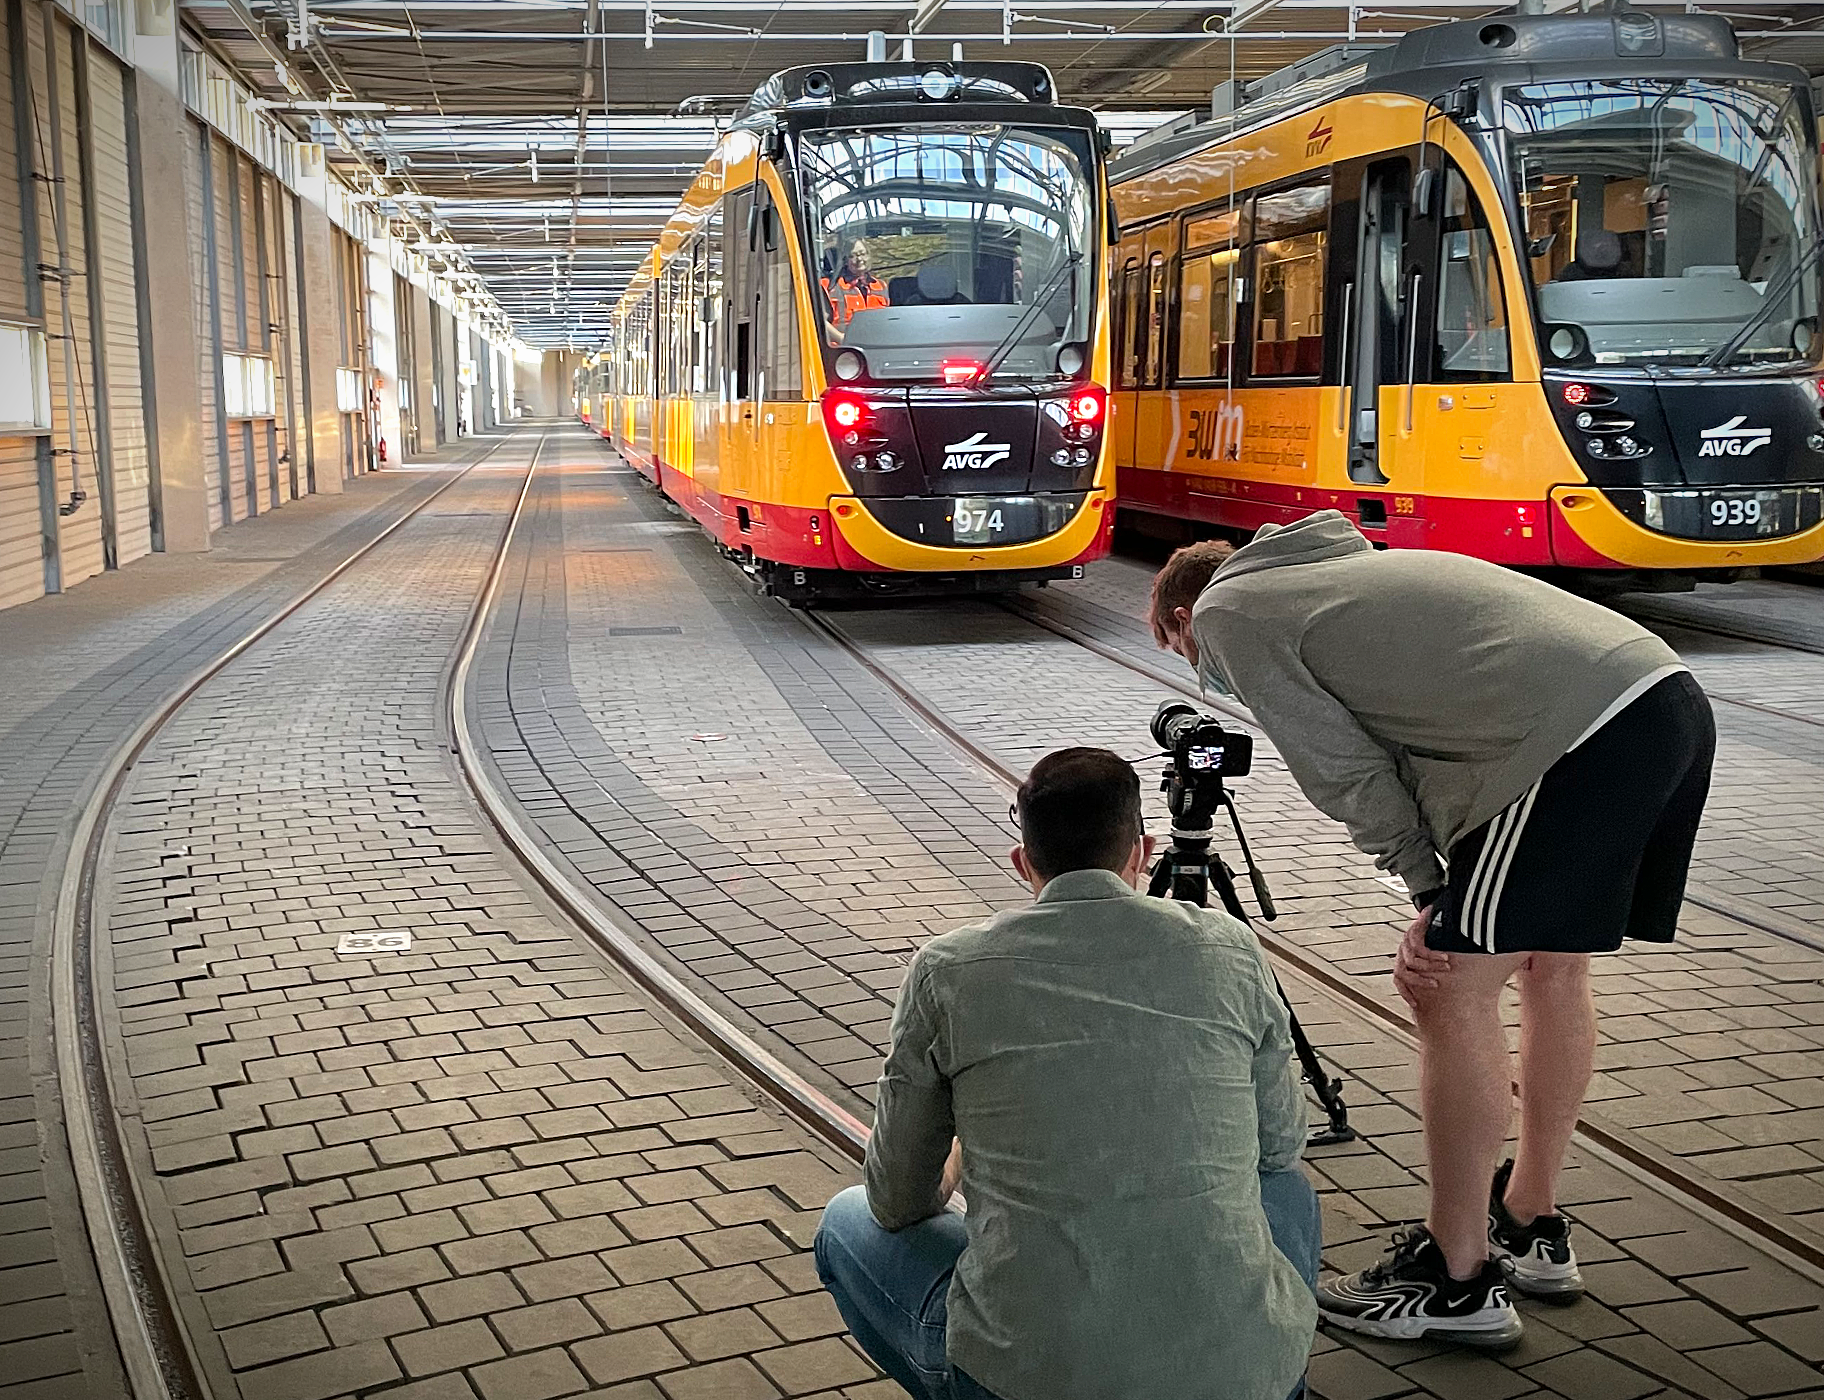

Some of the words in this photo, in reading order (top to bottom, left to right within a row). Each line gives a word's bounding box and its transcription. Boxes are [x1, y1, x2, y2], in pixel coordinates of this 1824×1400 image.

[1698, 439, 1742, 457] AVG
[942, 453, 982, 470] AVG
[956, 509, 1004, 533] 974
[1710, 500, 1760, 525] 939
[794, 571, 807, 585] B
[1072, 565, 1083, 579] B
[346, 937, 403, 948] 86
